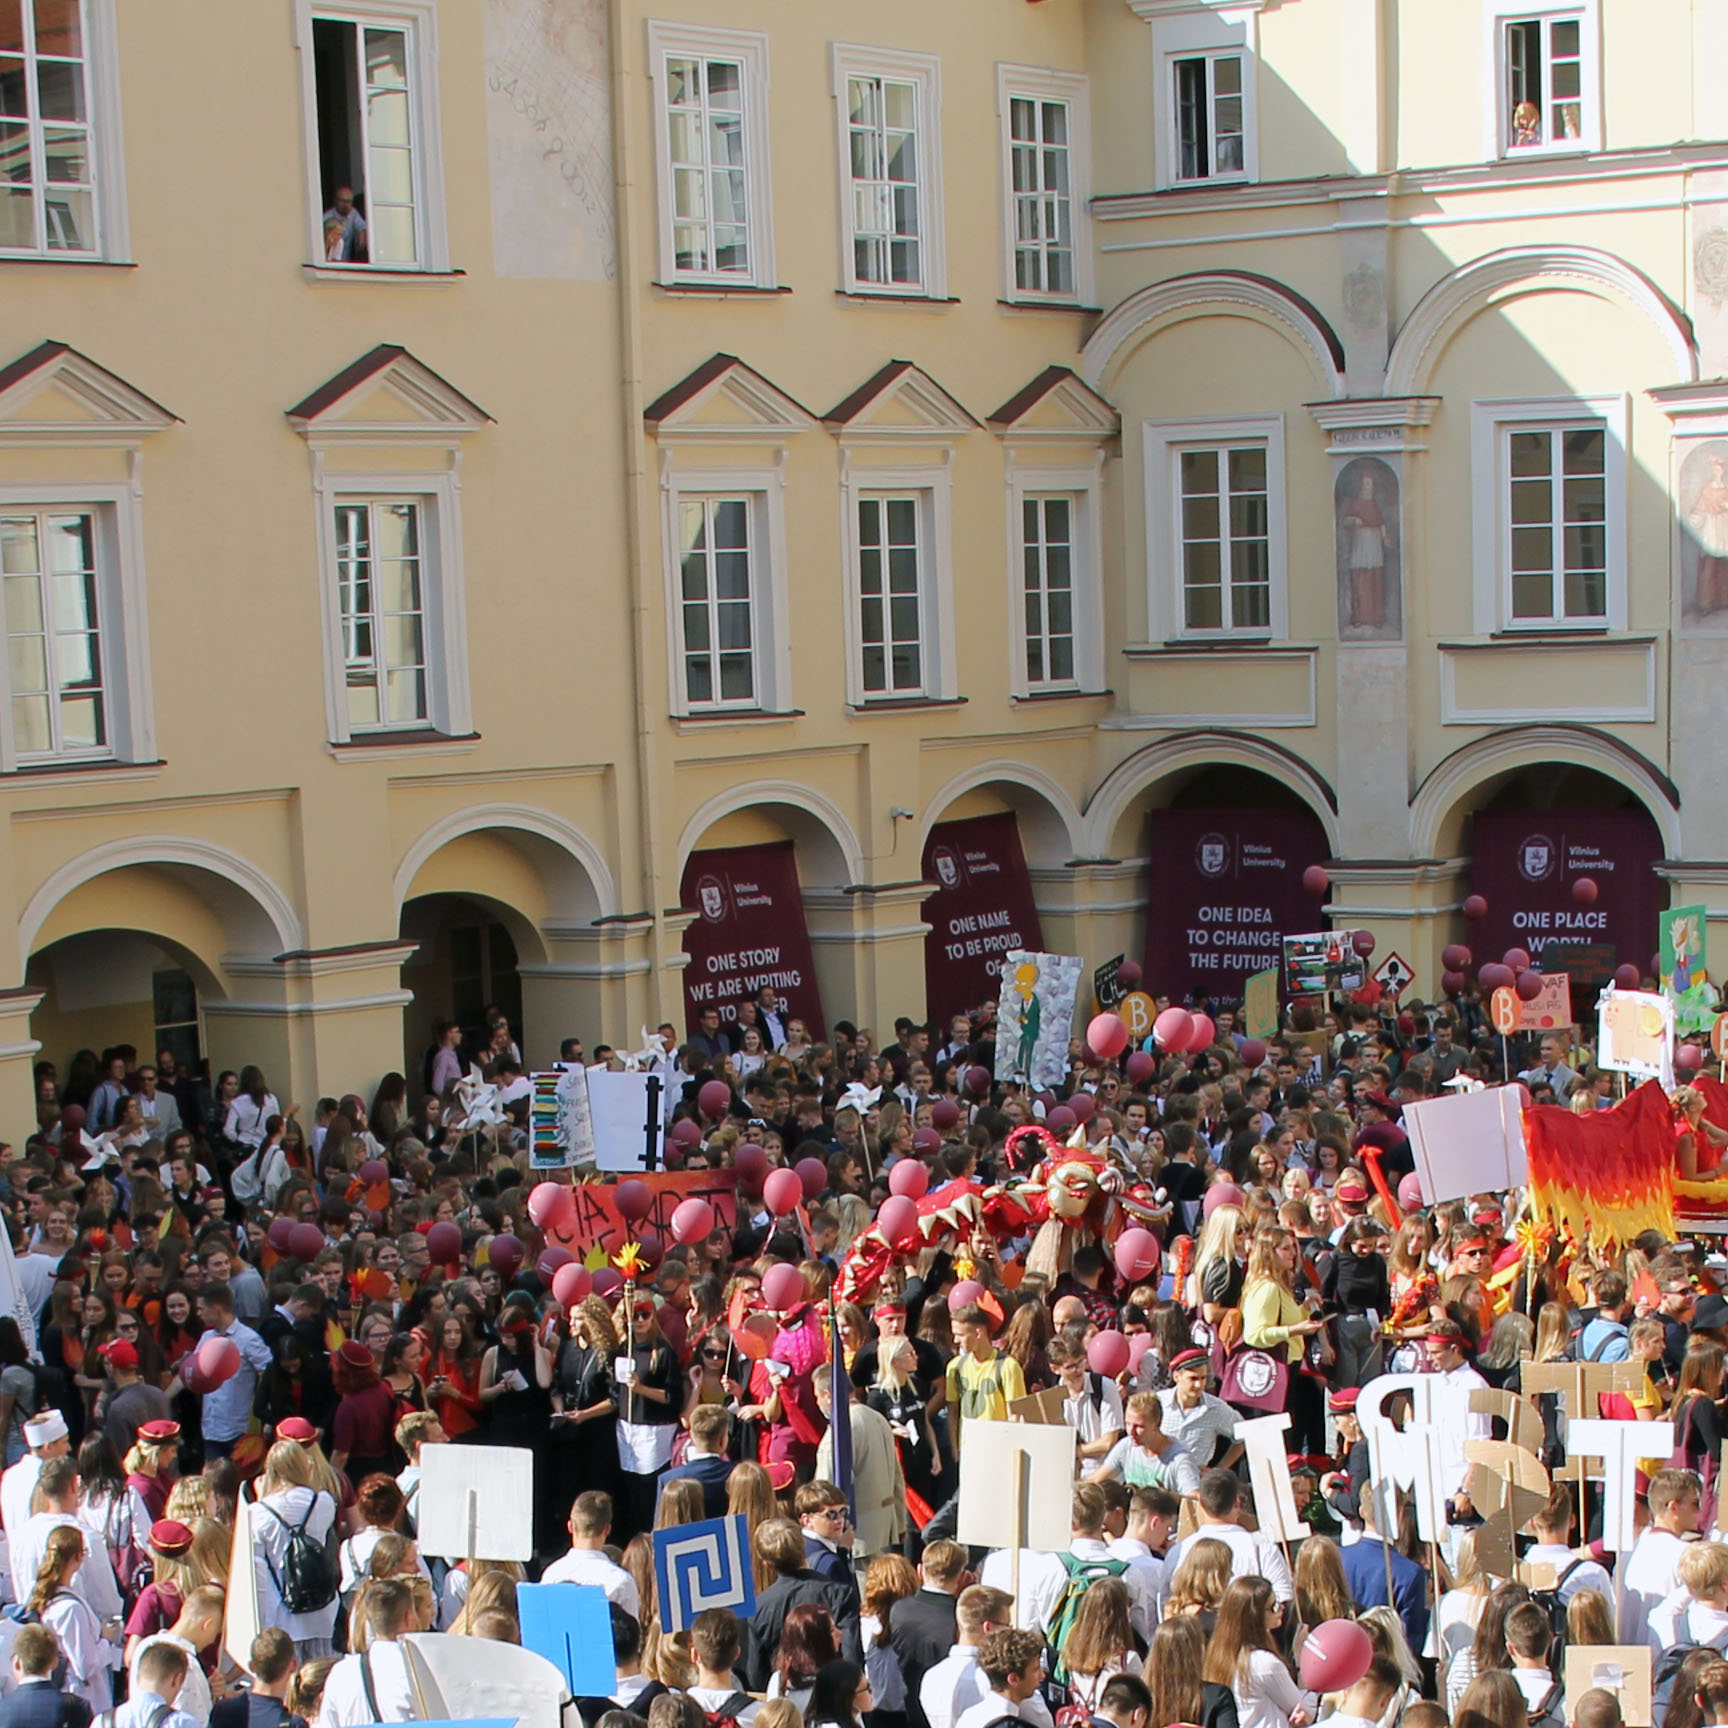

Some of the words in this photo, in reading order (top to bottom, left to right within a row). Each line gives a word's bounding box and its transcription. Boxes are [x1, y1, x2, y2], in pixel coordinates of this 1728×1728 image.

[1243, 845, 1272, 854] Vilnius
[1569, 847, 1600, 856] Vilnius
[1243, 858, 1286, 869] University
[1568, 860, 1615, 871] University
[734, 883, 759, 894] Vilnius
[737, 895, 772, 907] University
[949, 915, 977, 935] ONE
[977, 910, 1011, 930] NAME
[1198, 906, 1233, 922] ONE
[1237, 907, 1273, 923] IDEA
[1512, 912, 1551, 928] ONE
[1555, 912, 1608, 928] PLACE
[945, 943, 965, 960] TO
[967, 939, 983, 957] BE
[983, 933, 1023, 952] PROUD
[1186, 930, 1209, 945] TO
[1212, 930, 1281, 947] CHANGE
[706, 954, 737, 973] ONE
[739, 947, 780, 969] STORY
[1189, 952, 1219, 968] THE
[1223, 953, 1280, 970] FUTURE
[689, 982, 715, 1002] WE
[717, 976, 743, 997] ARE
[744, 969, 802, 993] WRITING
